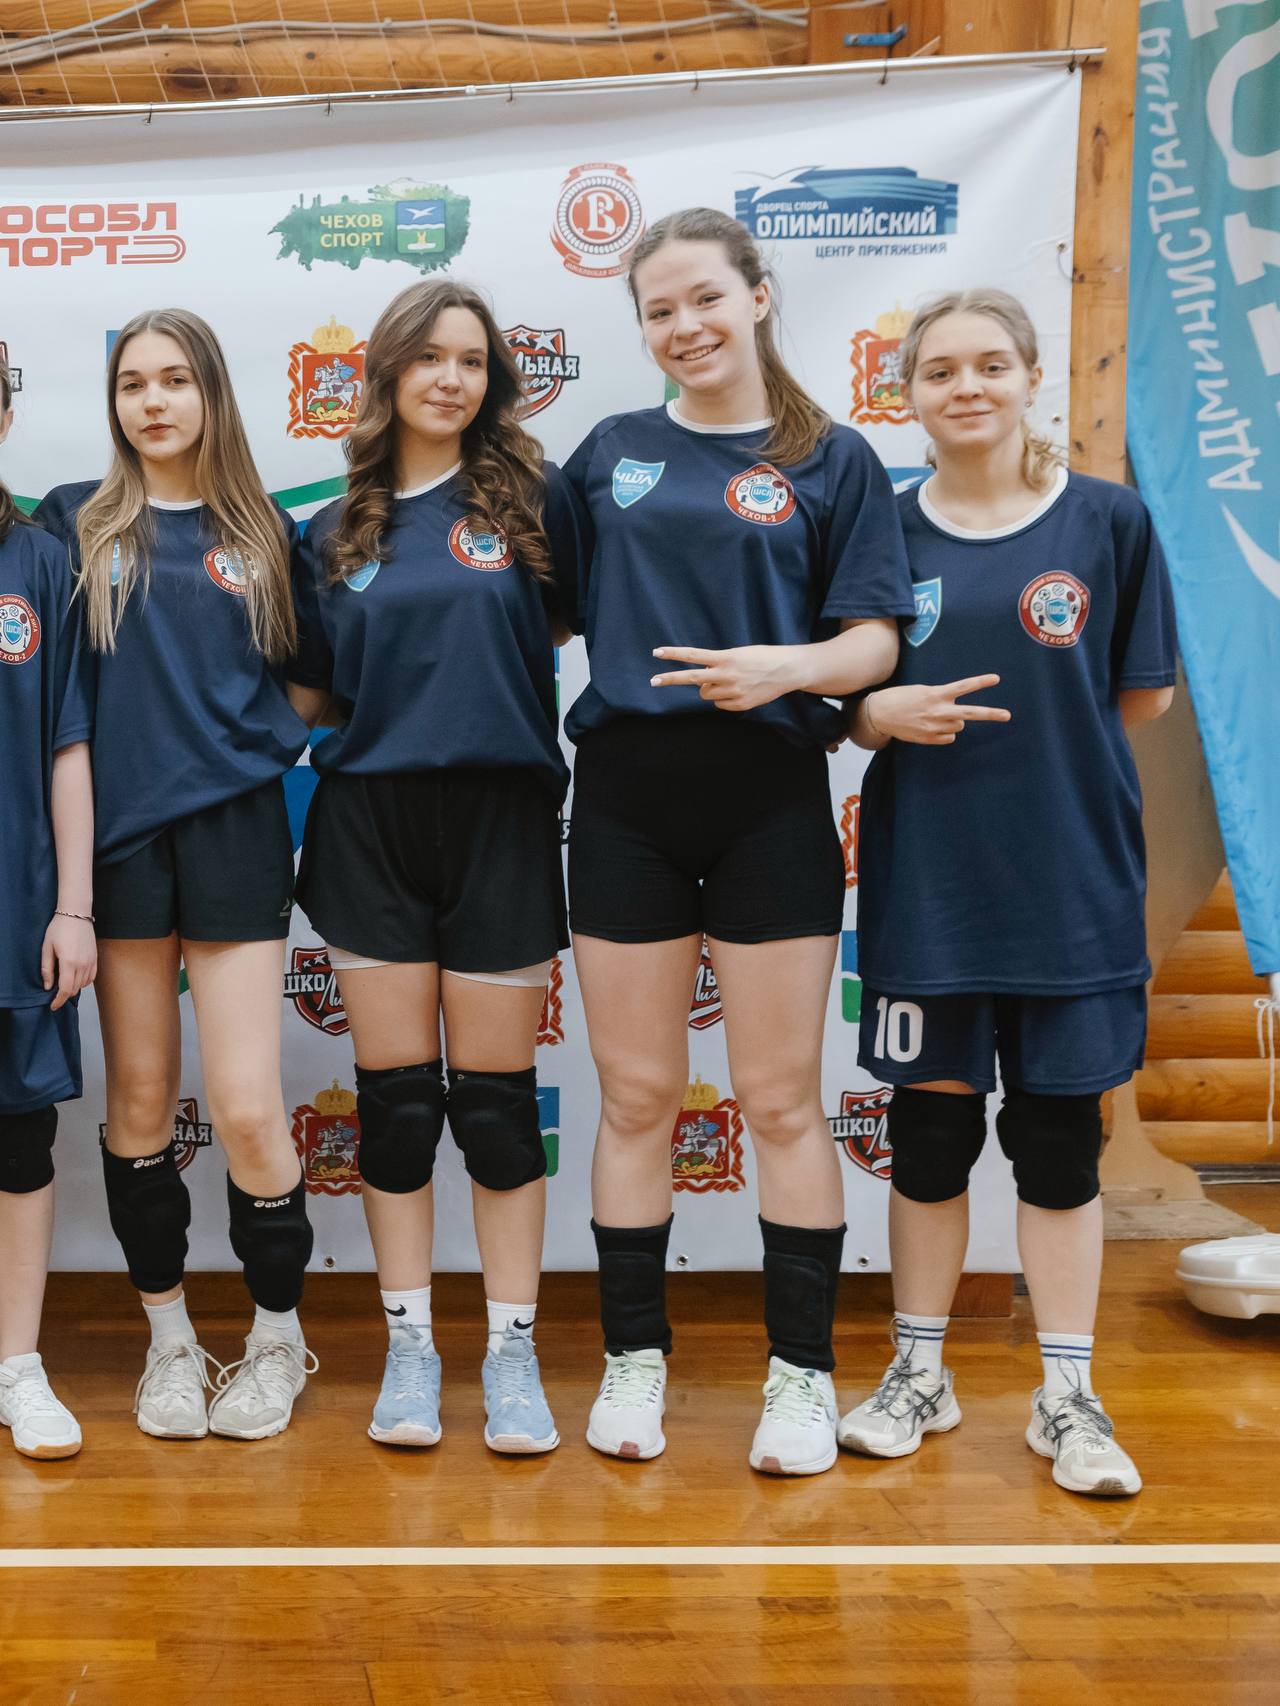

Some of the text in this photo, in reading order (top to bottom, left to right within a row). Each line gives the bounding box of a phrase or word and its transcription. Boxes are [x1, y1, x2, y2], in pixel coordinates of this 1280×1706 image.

[793, 200, 829, 212] СПОРТА
[320, 214, 384, 229] ЧЕХОВ
[756, 205, 938, 238] ОЛИМПИЙСКИЙ
[320, 232, 385, 248] СПОРТ
[815, 242, 948, 258] ЦЕНТР ПРИТЯЖЕНИЯ
[1138, 27, 1264, 492] АДМИНИСТРАЦИЯ
[470, 559, 507, 569] ЧЕХОВ-2
[873, 997, 924, 1063] 10
